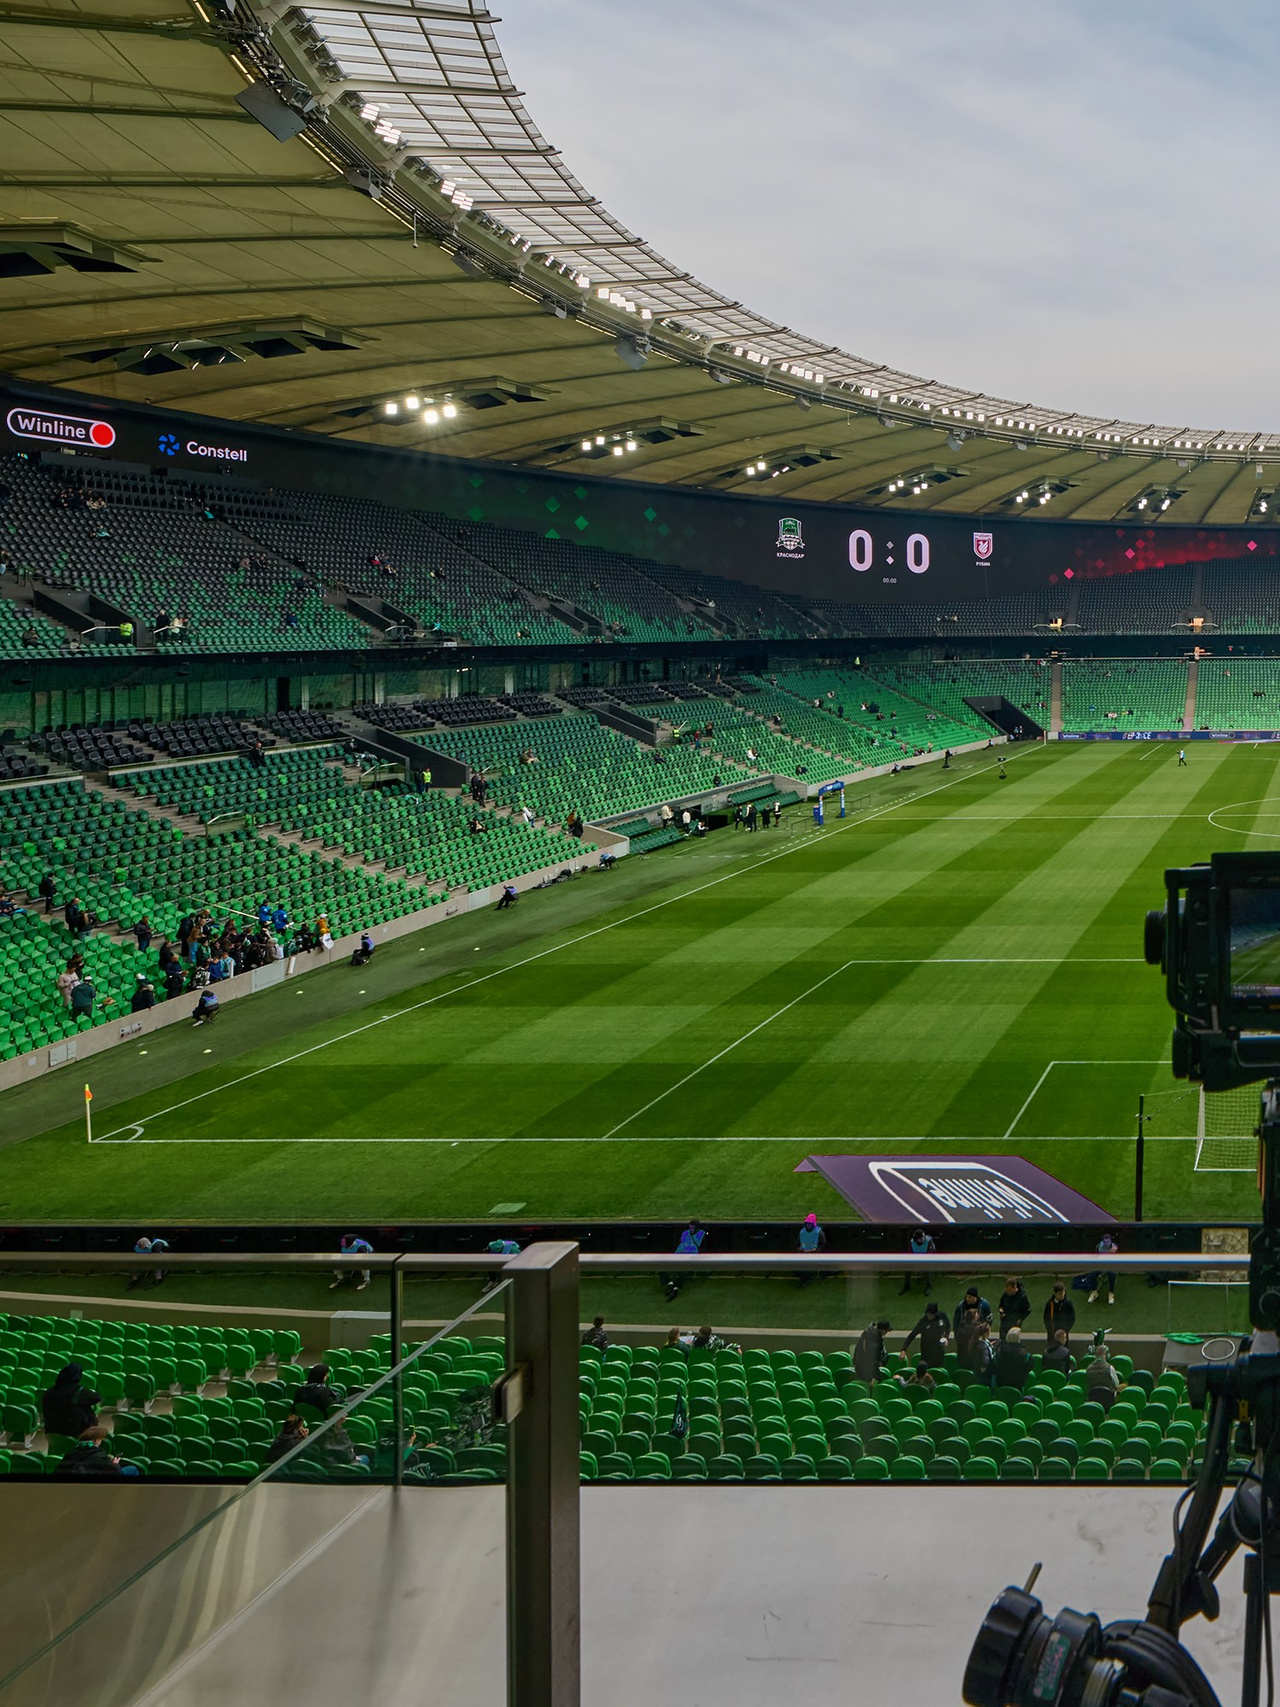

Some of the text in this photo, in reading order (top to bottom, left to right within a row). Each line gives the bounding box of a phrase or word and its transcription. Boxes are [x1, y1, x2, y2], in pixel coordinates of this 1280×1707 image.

[17, 414, 86, 439] Winline
[186, 440, 248, 462] Constell
[849, 529, 873, 572] 0
[906, 533, 930, 574] 0
